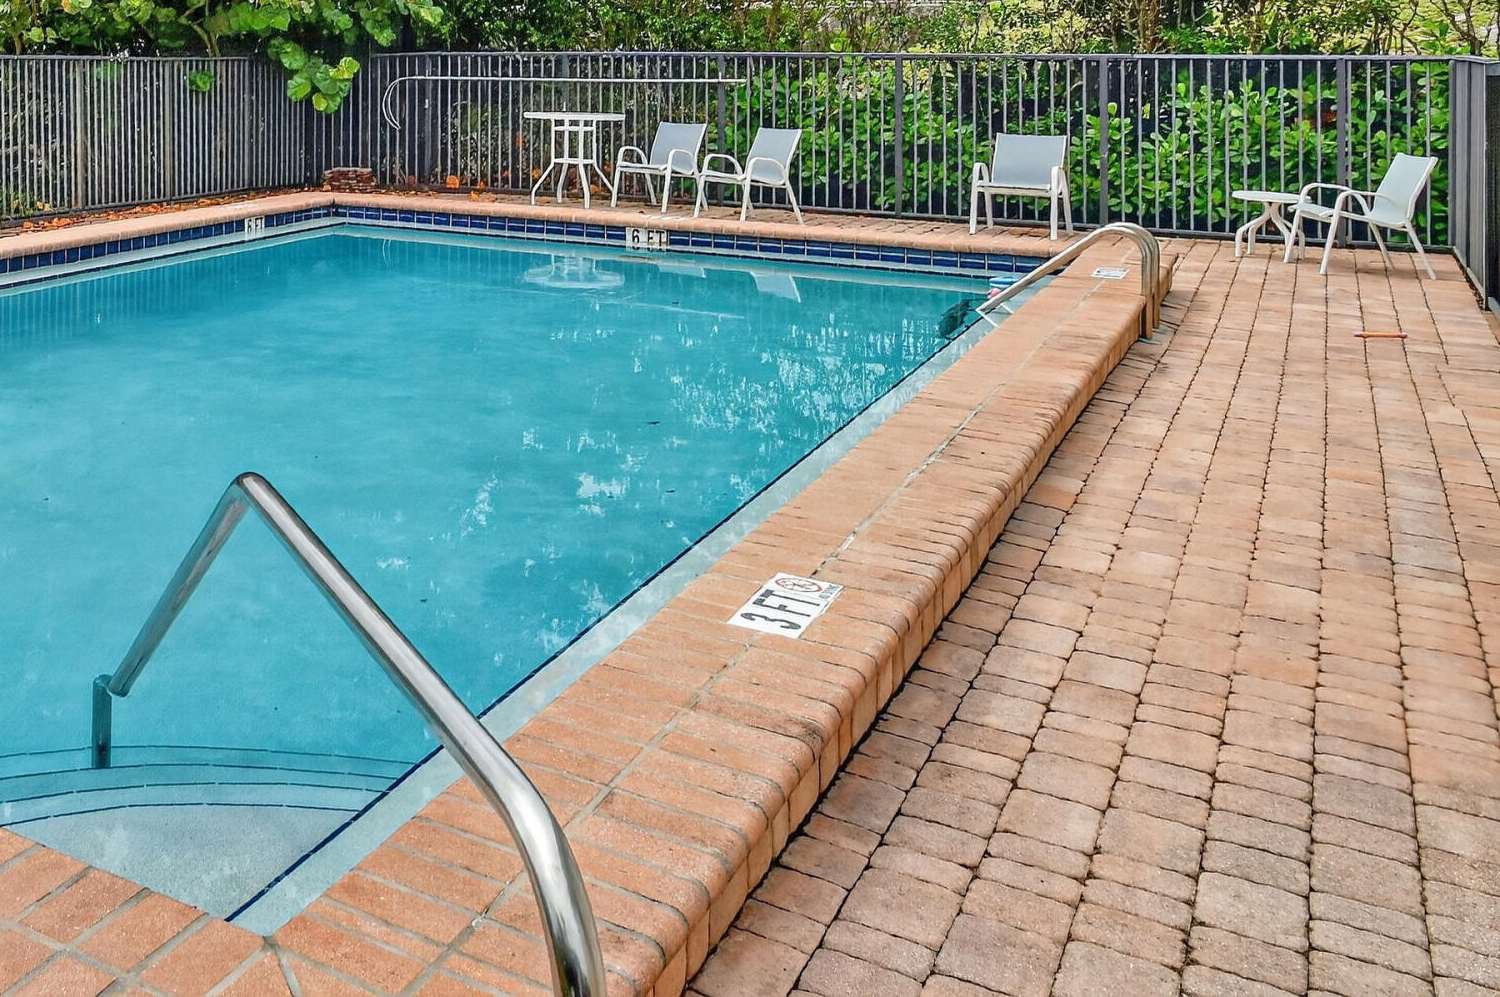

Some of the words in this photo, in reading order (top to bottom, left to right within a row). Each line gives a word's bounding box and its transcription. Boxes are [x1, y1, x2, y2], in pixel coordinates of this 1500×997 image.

[631, 229, 640, 244] 6
[647, 230, 665, 246] FT
[752, 589, 820, 617] FT
[740, 612, 801, 630] 3
